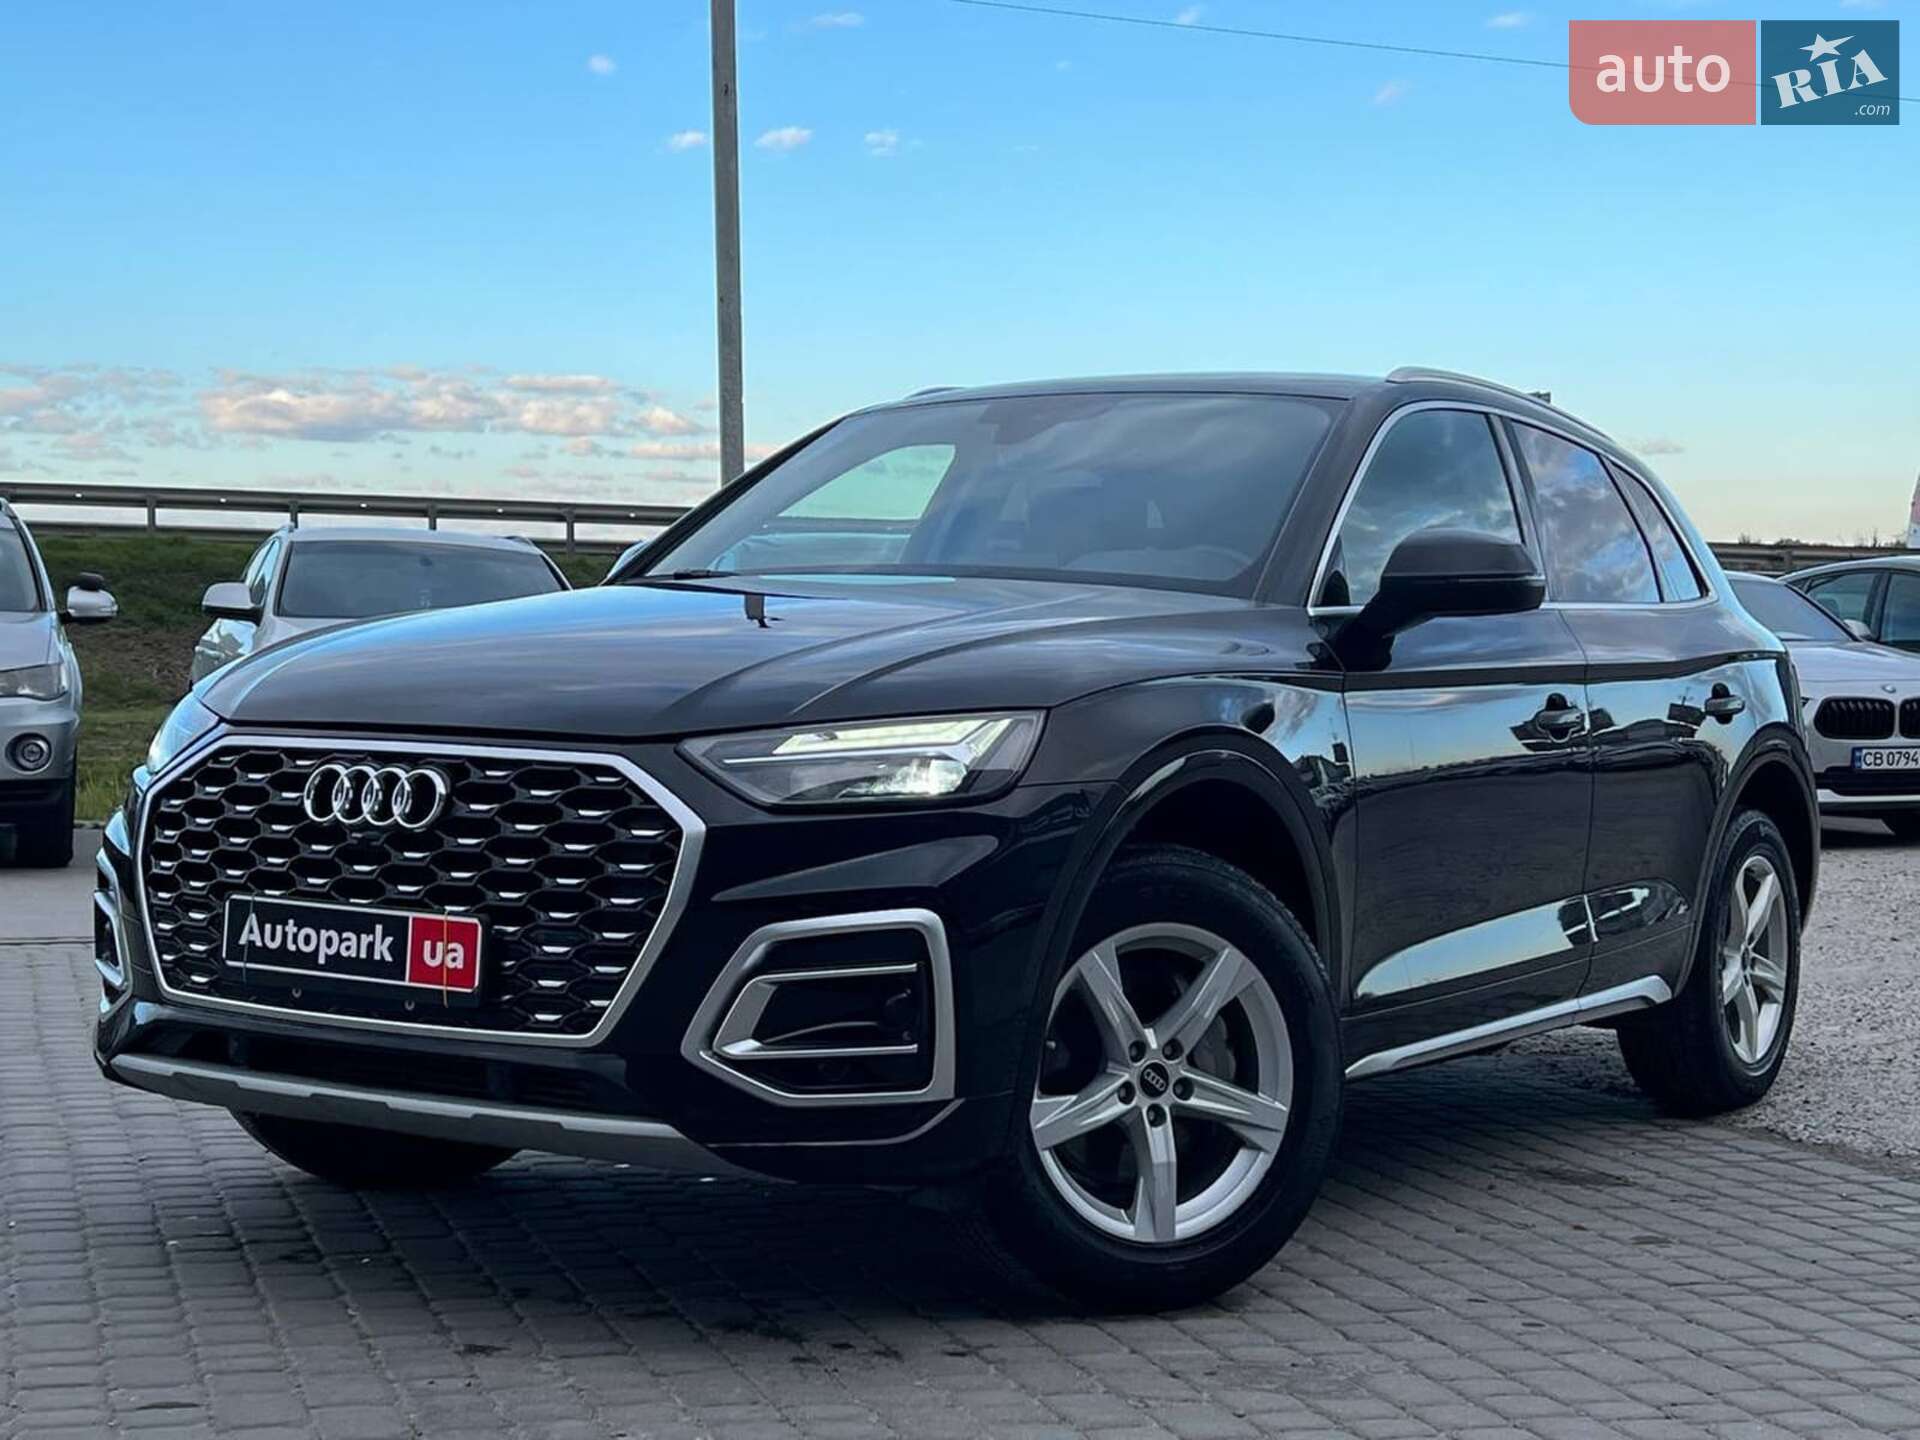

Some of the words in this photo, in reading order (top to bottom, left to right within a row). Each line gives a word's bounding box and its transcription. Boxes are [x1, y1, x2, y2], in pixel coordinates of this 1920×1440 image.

[1863, 751, 1884, 767] CB
[1886, 750, 1919, 767] 0794
[238, 912, 394, 965] Autopark
[423, 939, 464, 970] ua
